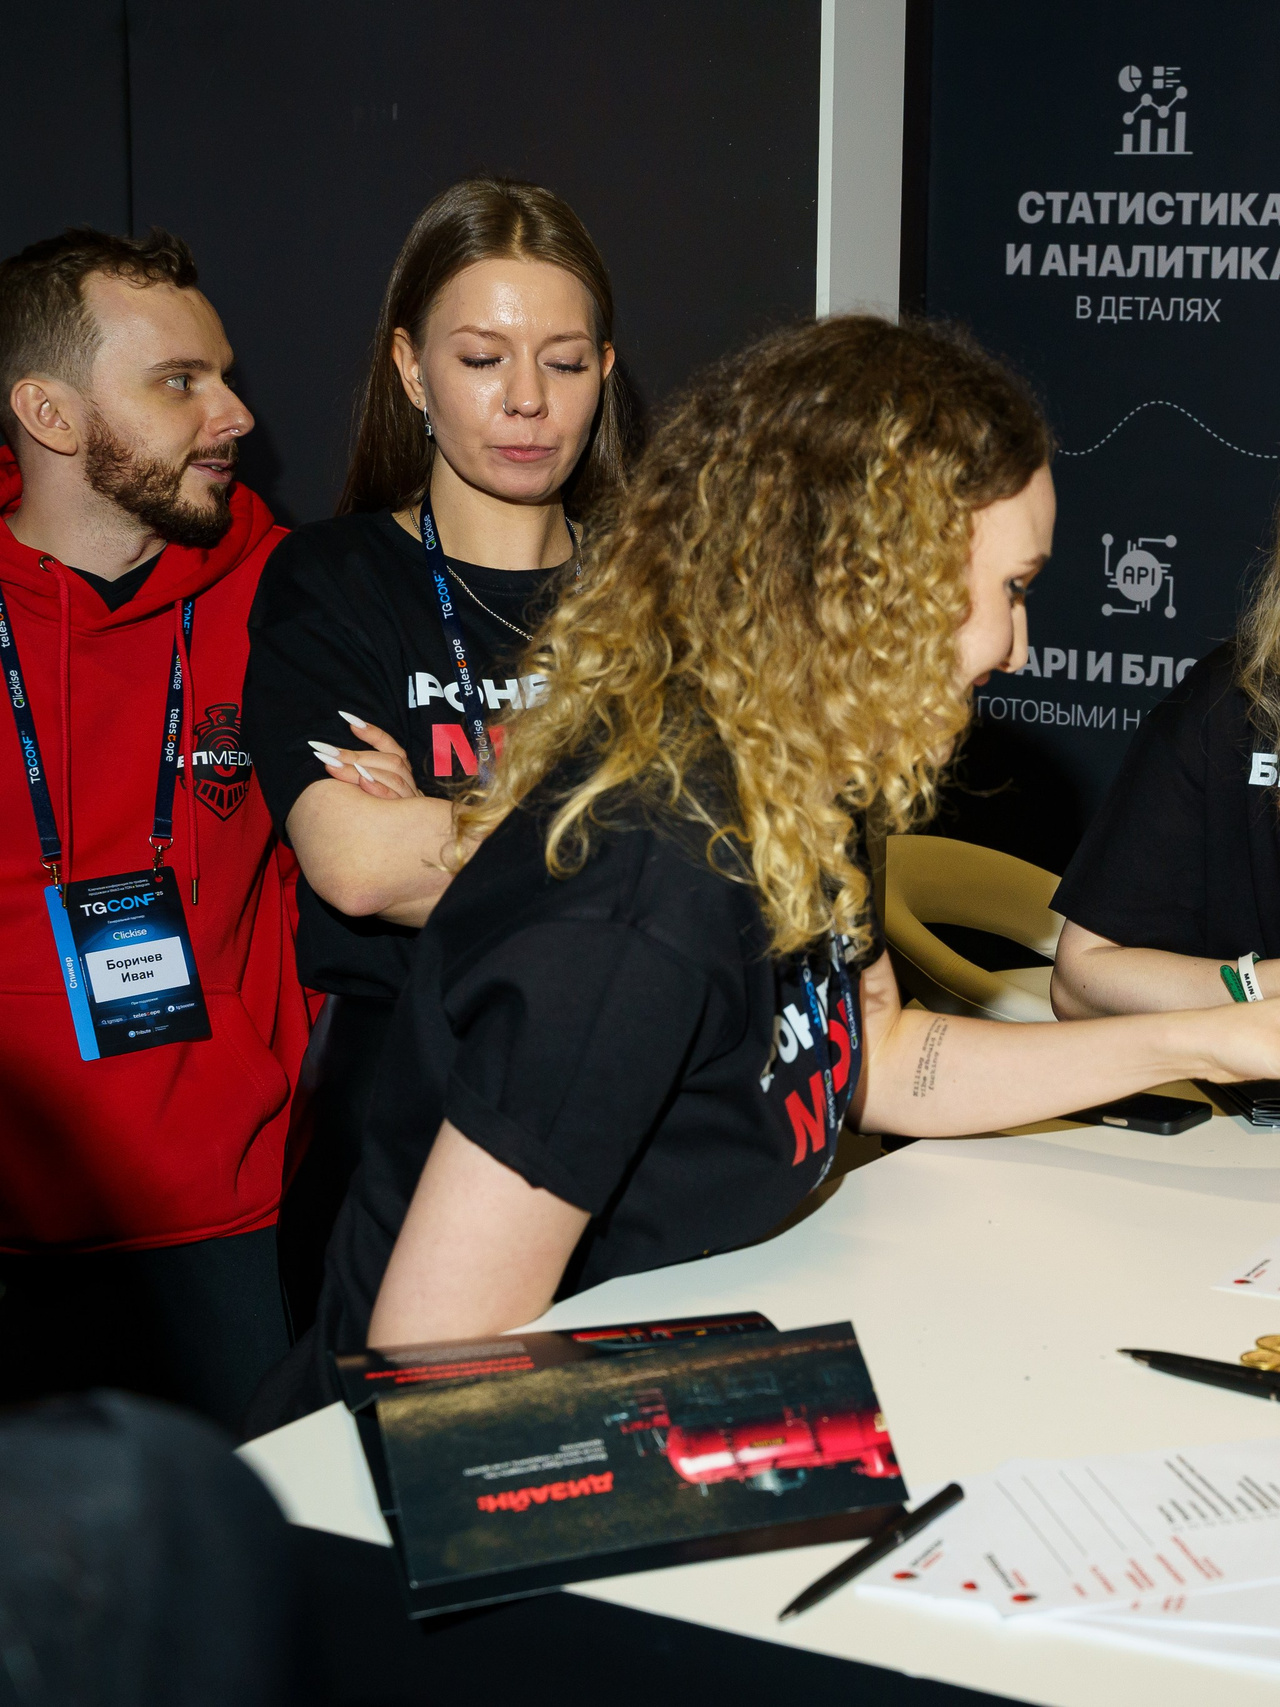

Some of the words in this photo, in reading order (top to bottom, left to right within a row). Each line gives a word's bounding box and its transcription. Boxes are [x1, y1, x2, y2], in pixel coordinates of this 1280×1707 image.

[1005, 243, 1032, 275] И
[1075, 295, 1092, 319] В
[1096, 296, 1222, 324] ДЕТАЛЯХ
[423, 514, 437, 550] Clickise
[1122, 565, 1156, 587] API
[434, 574, 454, 619] TGCONF
[453, 638, 474, 697] telescope
[1014, 646, 1078, 680] API
[1086, 651, 1113, 683] И
[9, 669, 26, 709] Clickise
[977, 695, 1116, 730] ГОТОВЫМИ
[165, 708, 181, 763] telescope
[22, 735, 41, 784] TGCONF
[80, 892, 155, 917] TGCONF
[112, 927, 148, 941] Clickise
[65, 956, 78, 989] Спикер
[106, 953, 163, 970] Боричев
[121, 970, 155, 983] Иван
[1243, 973, 1255, 995] MAIN
[912, 1056, 925, 1098] Killing
